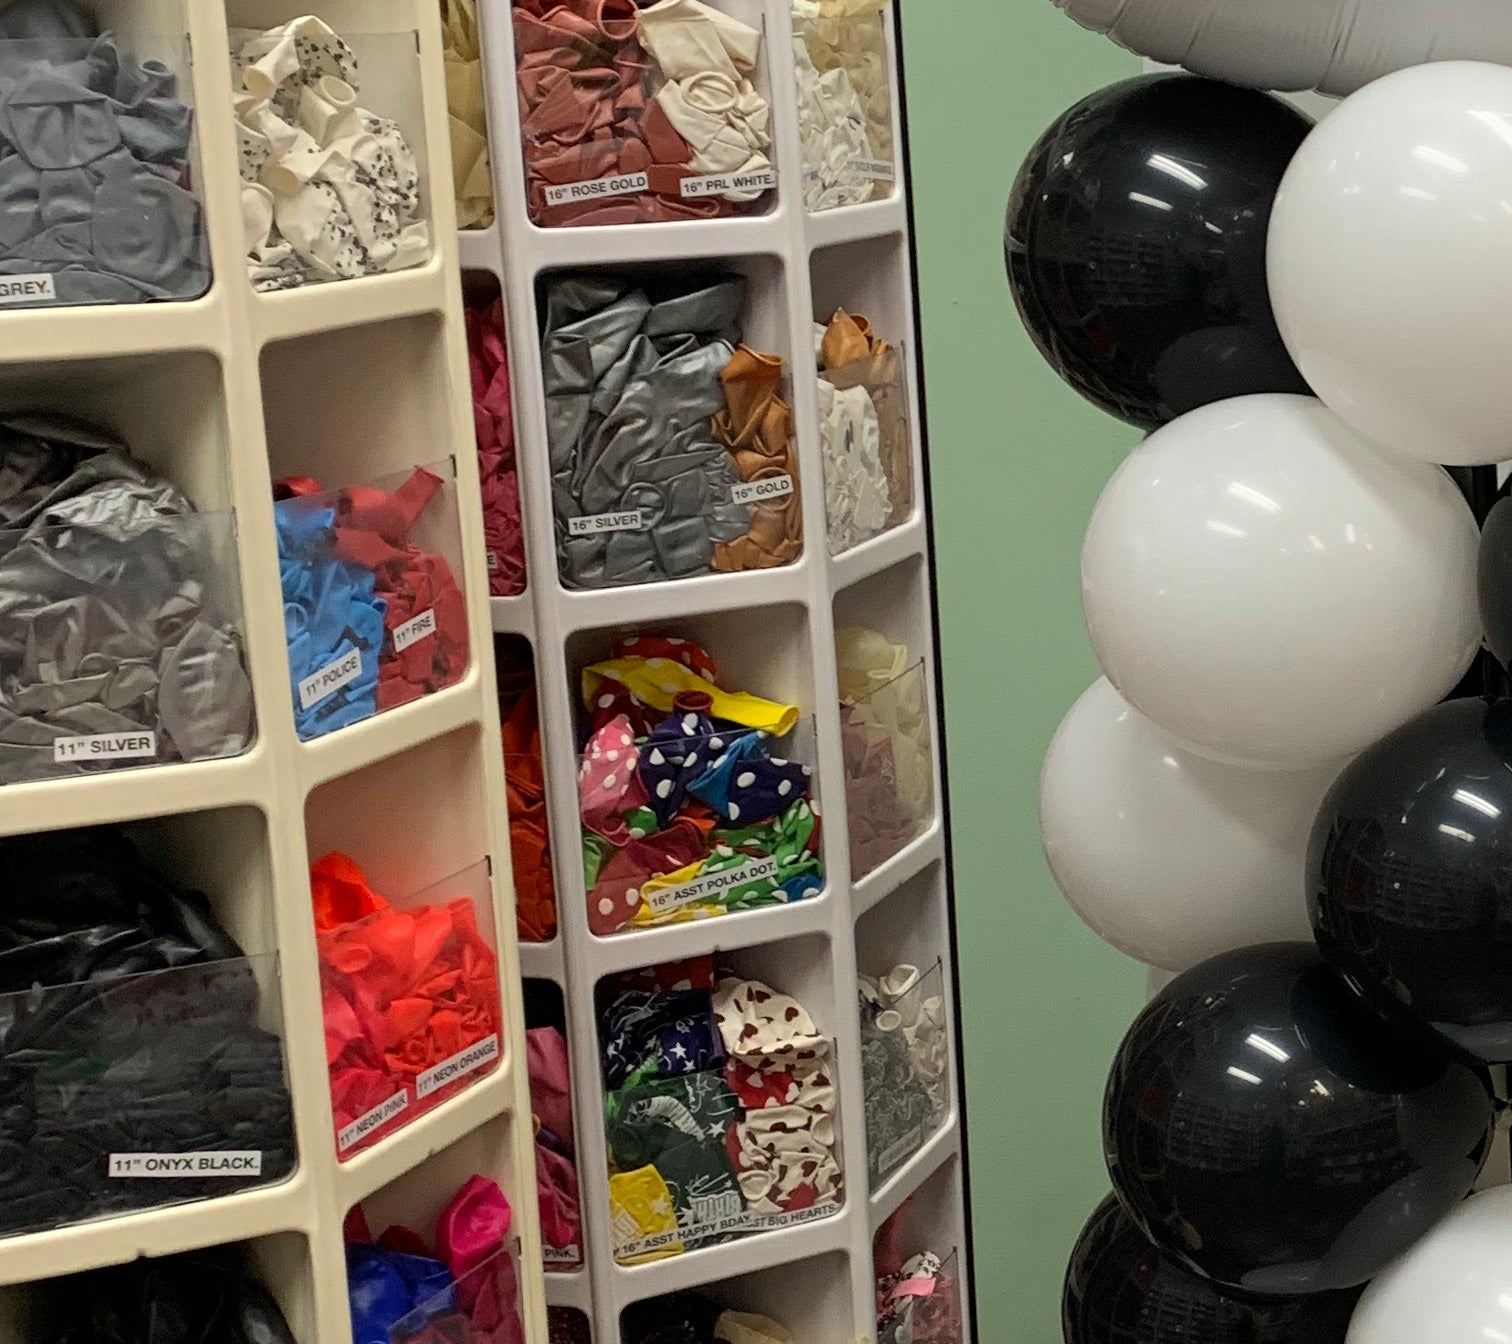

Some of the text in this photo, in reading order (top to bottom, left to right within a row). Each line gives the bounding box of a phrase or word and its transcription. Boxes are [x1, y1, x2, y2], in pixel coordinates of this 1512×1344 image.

[571, 180, 608, 197] ROSE
[611, 175, 647, 192] GOLD
[706, 179, 731, 192] PRL
[756, 479, 790, 496] GOLD
[595, 513, 640, 529] SILVER
[411, 615, 432, 633] FIRE
[321, 655, 360, 688] POLICE
[58, 737, 151, 756] 11" SILVER
[672, 884, 705, 902] ASST
[707, 869, 748, 891] POLKA
[433, 1060, 460, 1081] NEON
[459, 1040, 497, 1067] ORANGE
[355, 1107, 381, 1133] NEON
[115, 1158, 142, 1172] 11"
[145, 1156, 193, 1171] ONYX
[768, 1210, 789, 1227] BIG
[644, 1232, 675, 1248] ASST
[677, 1222, 715, 1239] HAPPY
